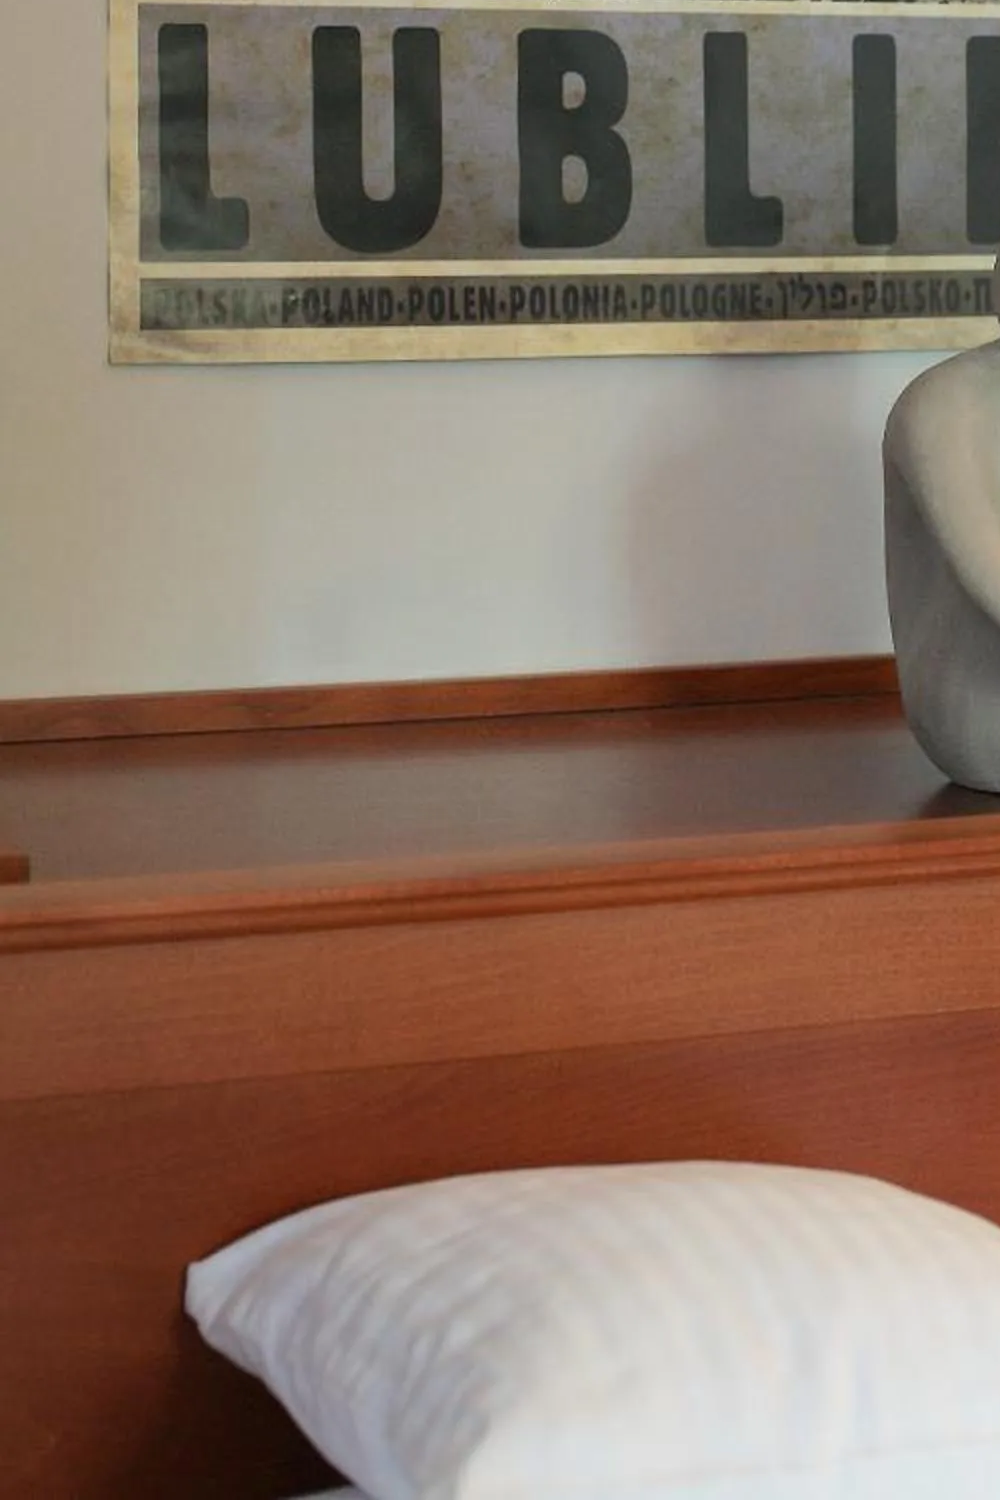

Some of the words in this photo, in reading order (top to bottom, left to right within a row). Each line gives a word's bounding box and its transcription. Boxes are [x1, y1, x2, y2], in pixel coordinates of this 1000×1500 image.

[280, 286, 394, 324] POLAND
[408, 285, 496, 322] POLEN
[509, 283, 628, 321] POLONIA
[641, 282, 763, 319] POLOGNE
[863, 279, 961, 315] POLSKO
